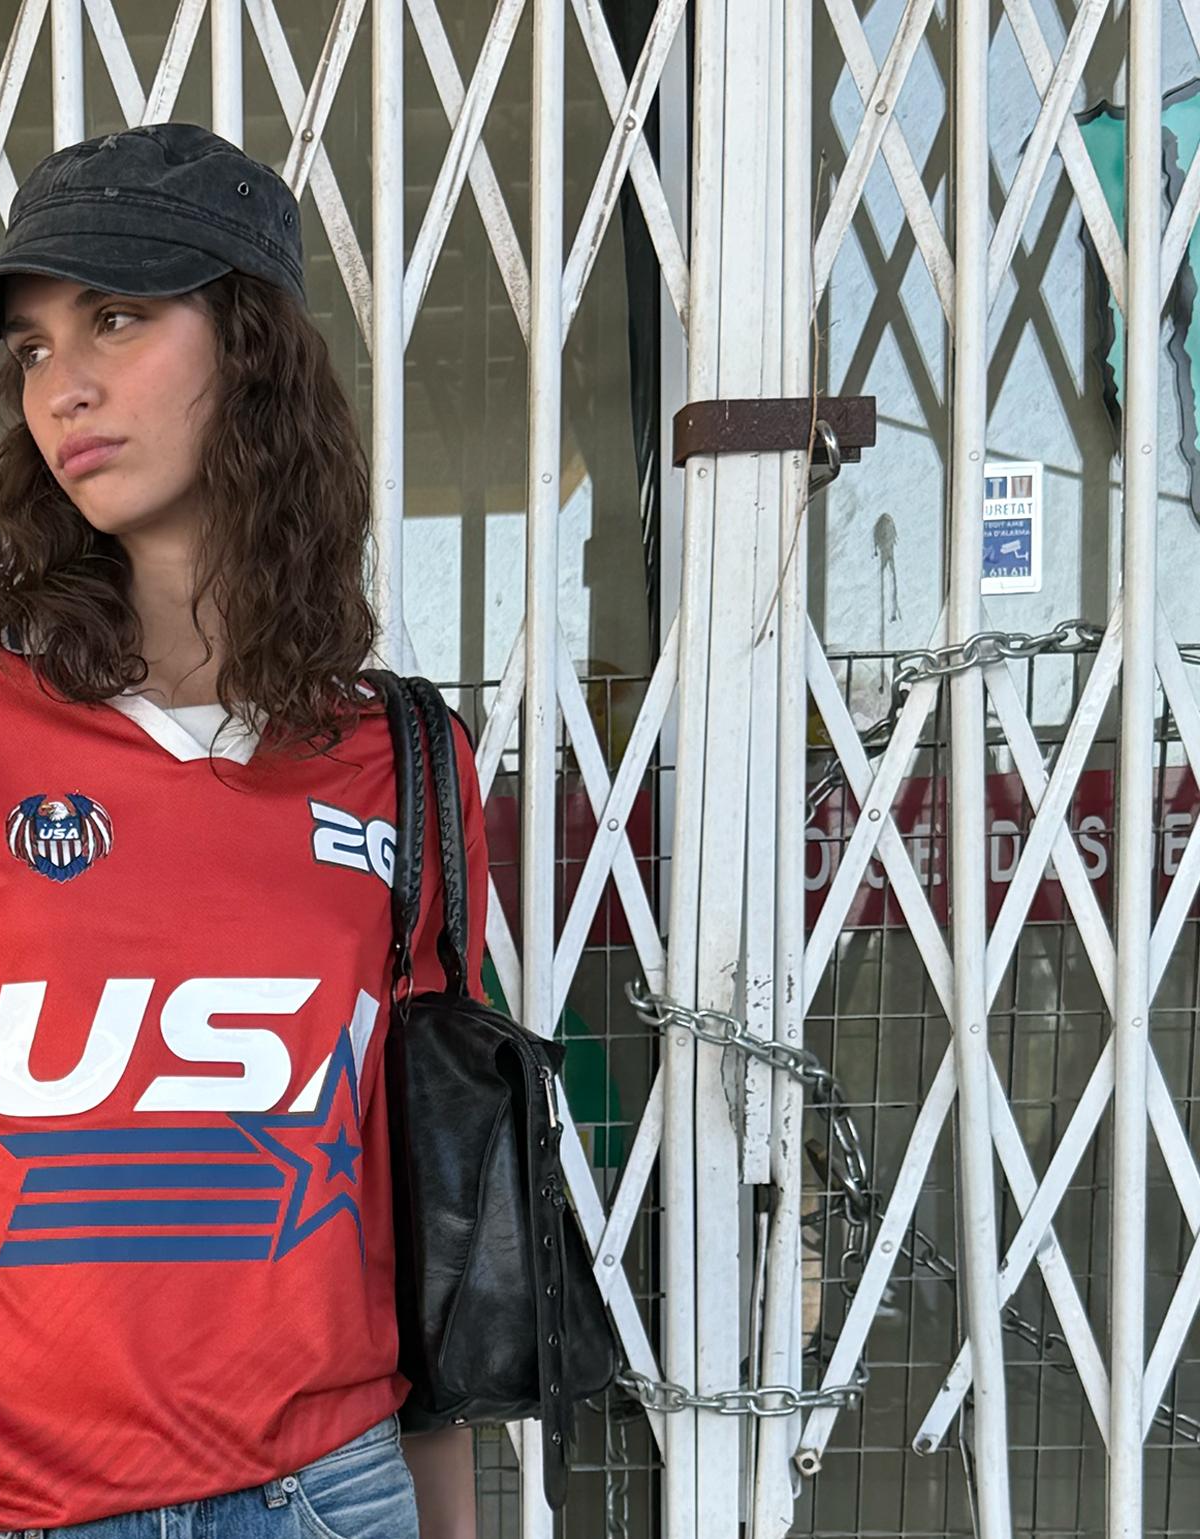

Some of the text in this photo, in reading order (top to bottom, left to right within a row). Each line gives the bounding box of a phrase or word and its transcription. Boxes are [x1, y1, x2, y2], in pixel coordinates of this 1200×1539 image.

[986, 477, 1031, 499] TV
[984, 503, 1032, 515] URETAT
[39, 828, 79, 839] USA
